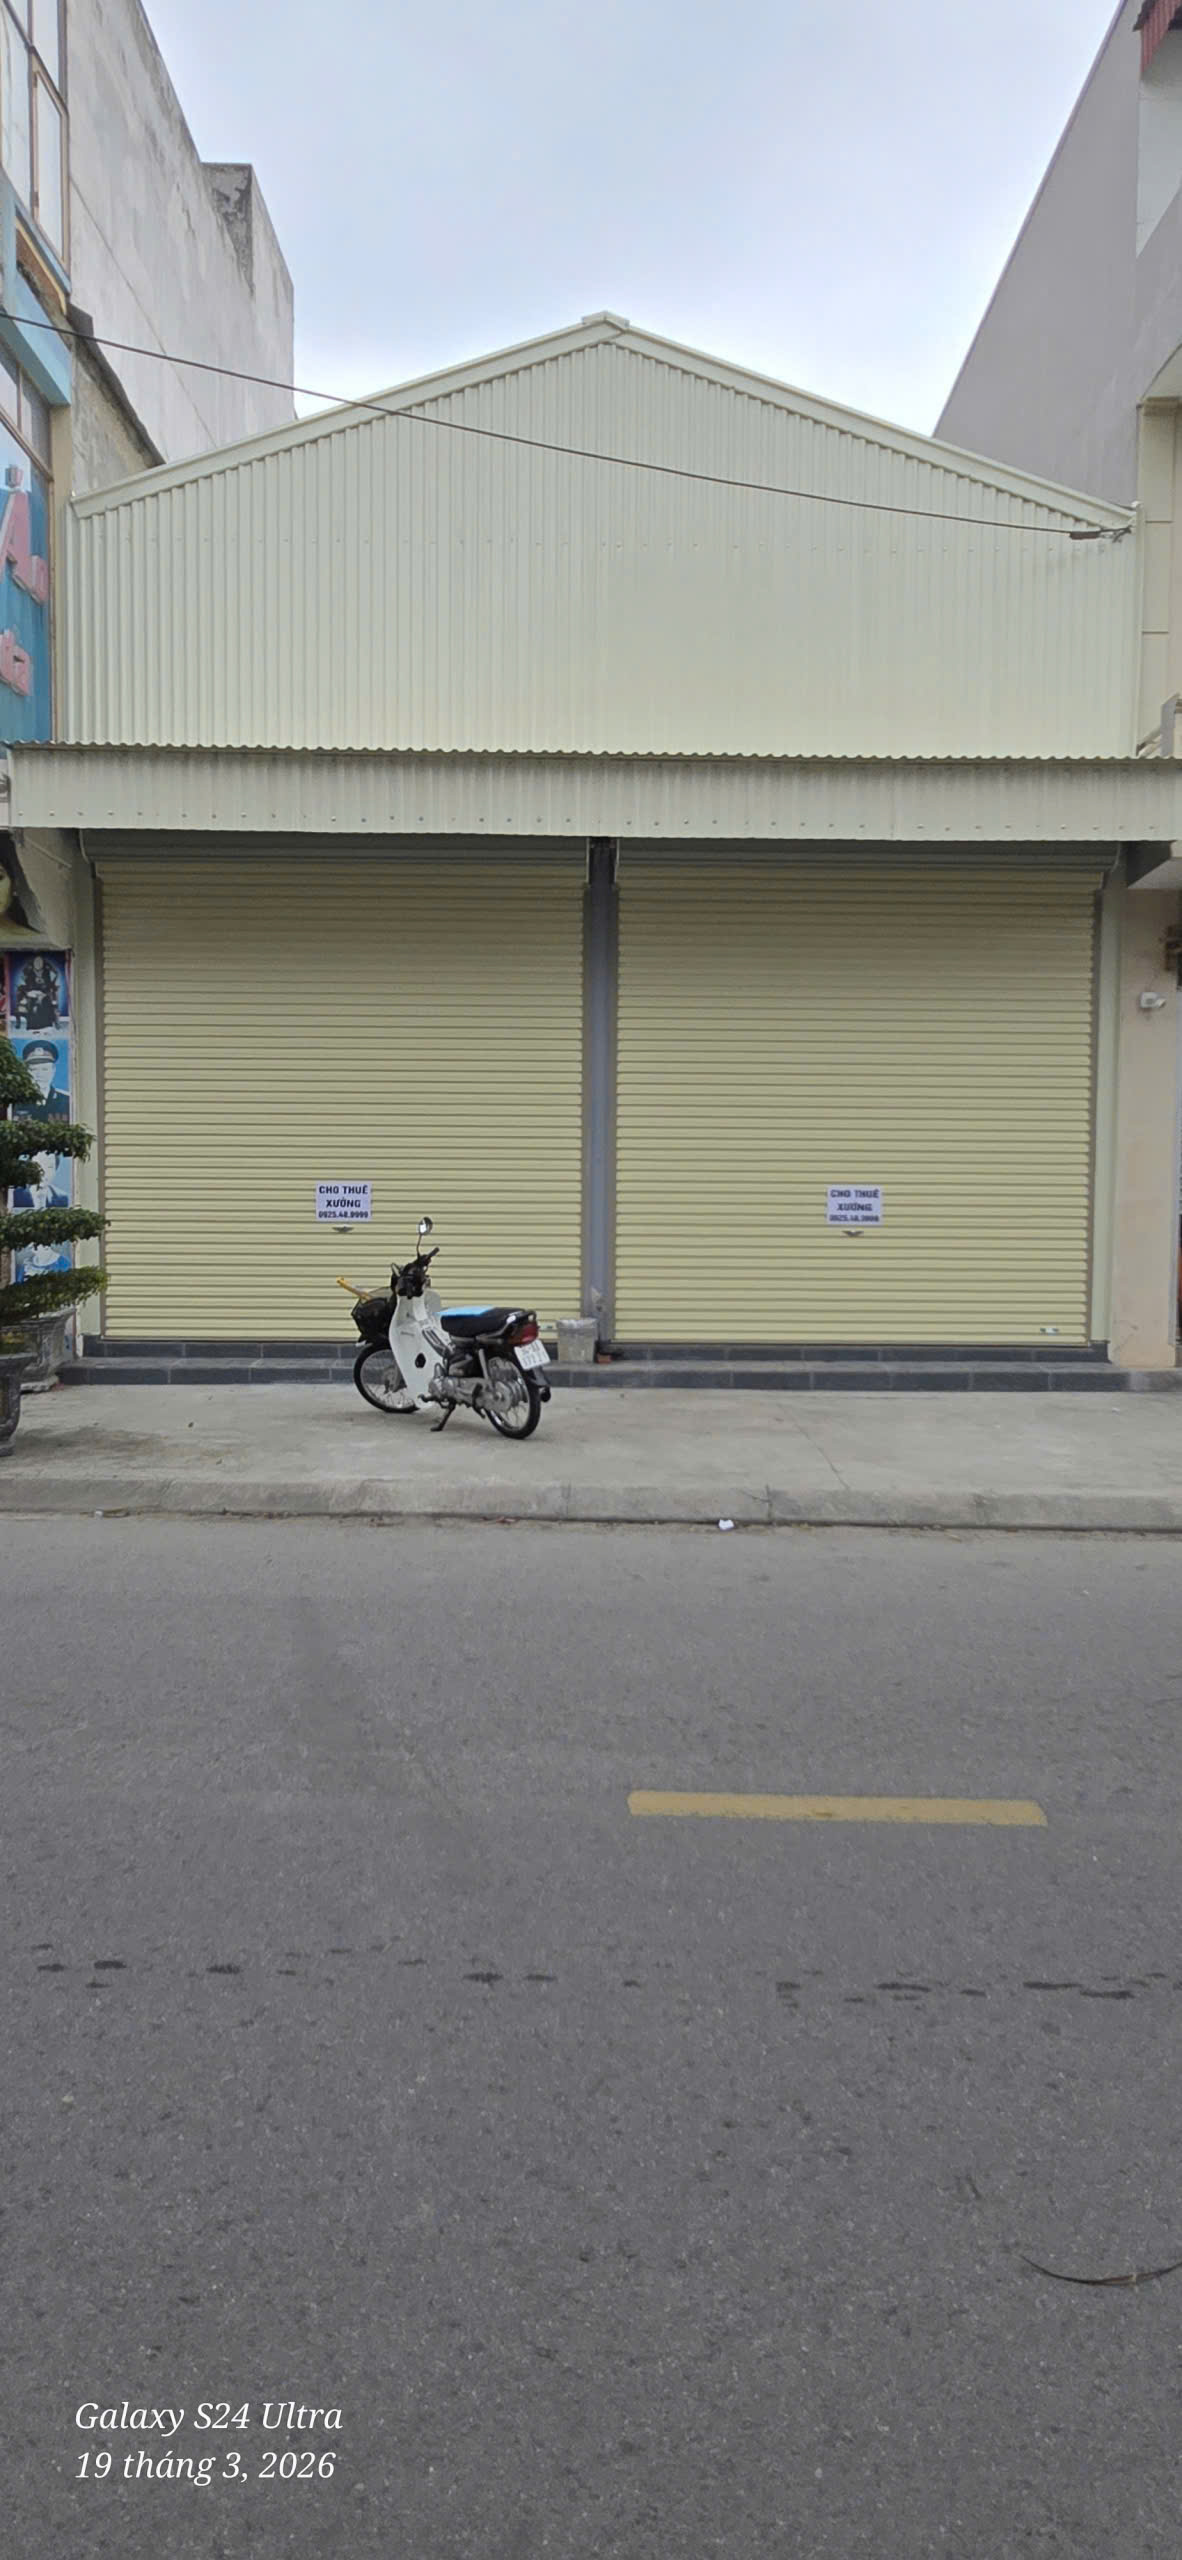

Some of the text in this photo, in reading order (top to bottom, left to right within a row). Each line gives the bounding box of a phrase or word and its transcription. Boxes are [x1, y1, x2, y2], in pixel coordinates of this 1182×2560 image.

[319, 1184, 368, 1195] CHO THUÊ
[830, 1189, 851, 1198] CHO
[326, 1196, 361, 1208] XƯỞNG
